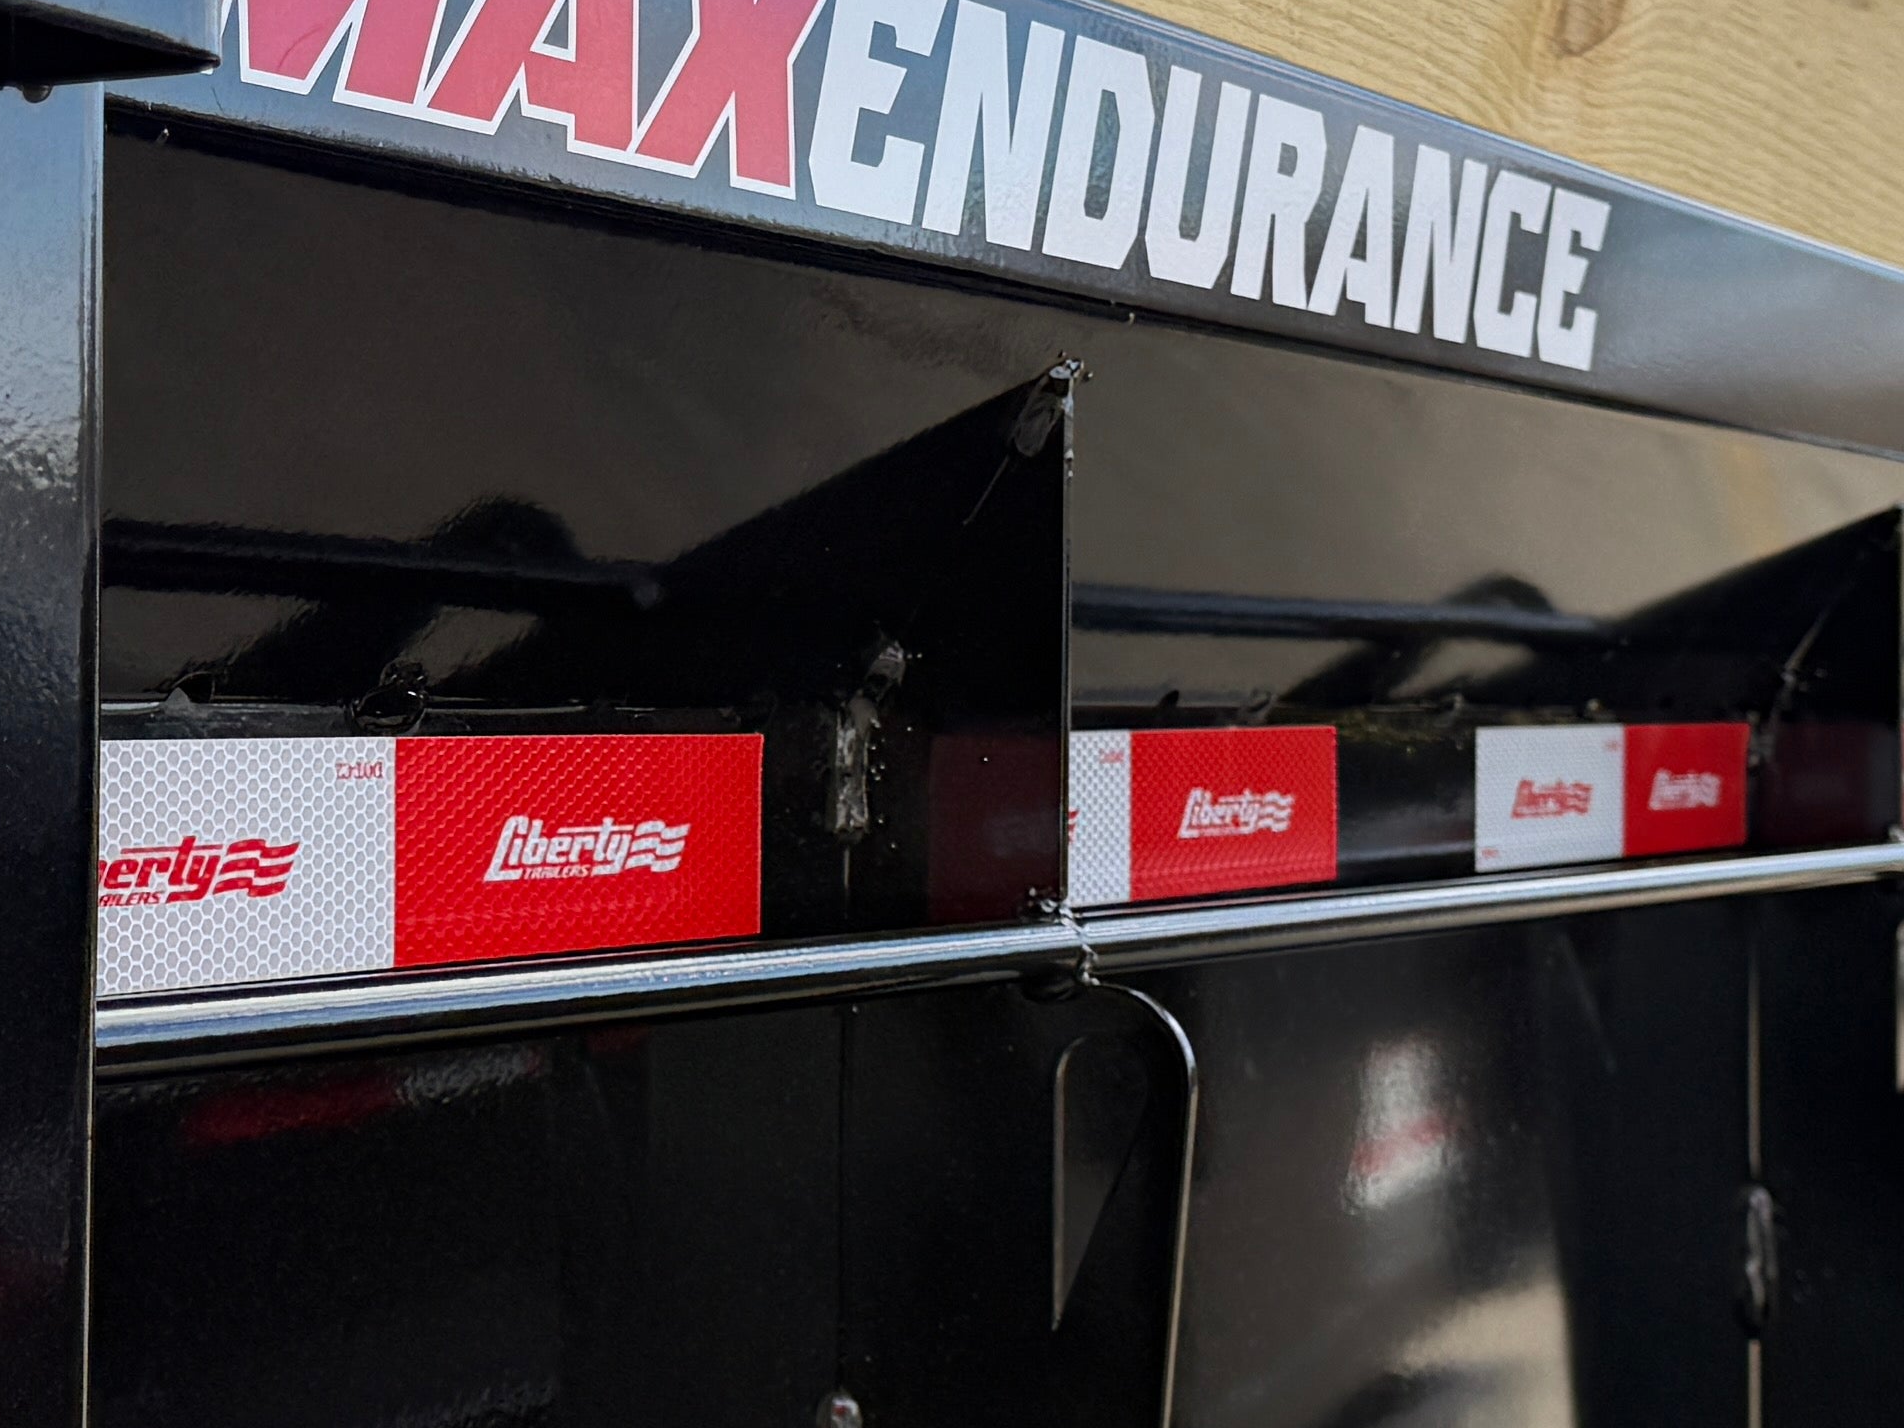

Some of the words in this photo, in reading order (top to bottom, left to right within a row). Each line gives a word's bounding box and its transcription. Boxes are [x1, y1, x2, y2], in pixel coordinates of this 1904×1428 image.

[1177, 787, 1263, 840] Liberty
[483, 815, 634, 882] Liberty
[524, 865, 591, 880] TRAILERS
